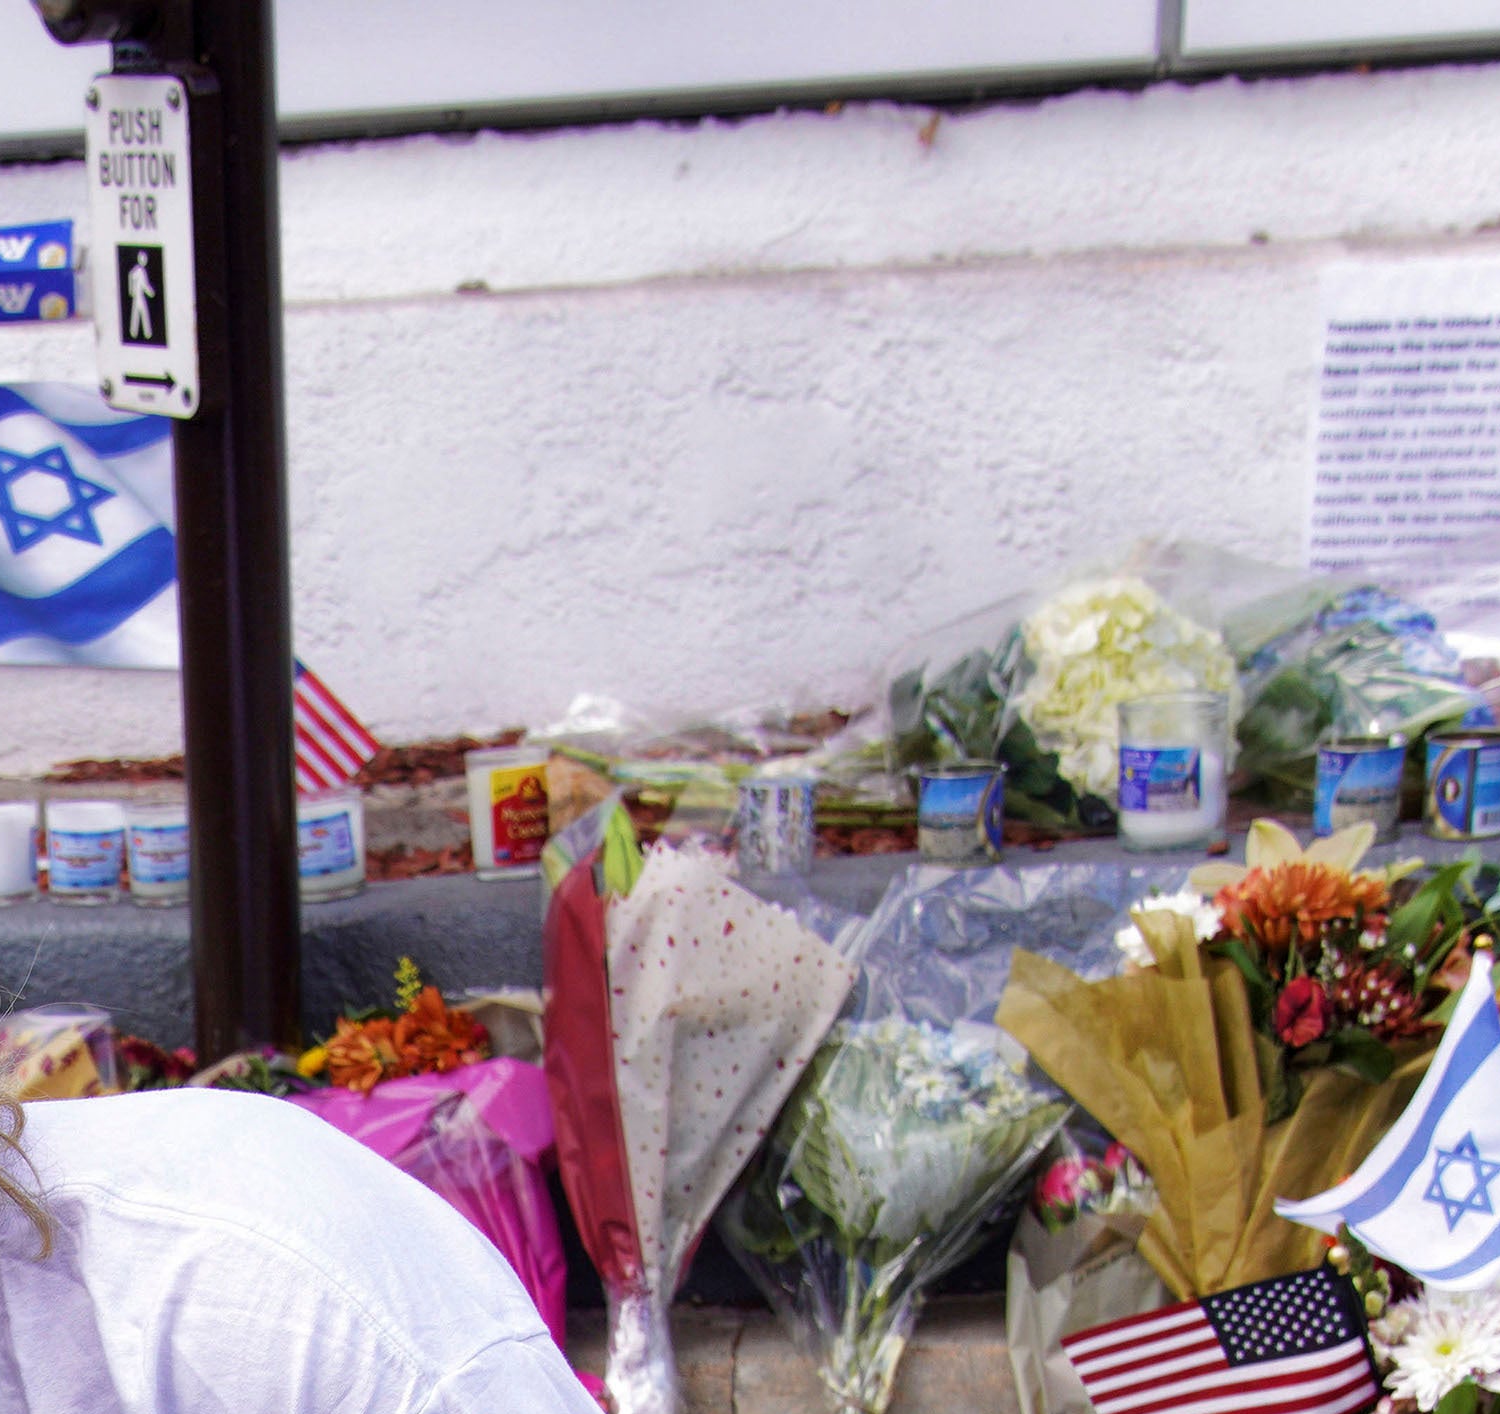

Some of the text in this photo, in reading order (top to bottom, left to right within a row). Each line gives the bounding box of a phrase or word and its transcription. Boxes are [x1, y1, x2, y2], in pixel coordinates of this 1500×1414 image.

[109, 110, 162, 145] PUSH
[100, 151, 176, 188] BUTTON
[119, 193, 157, 230] FOR
